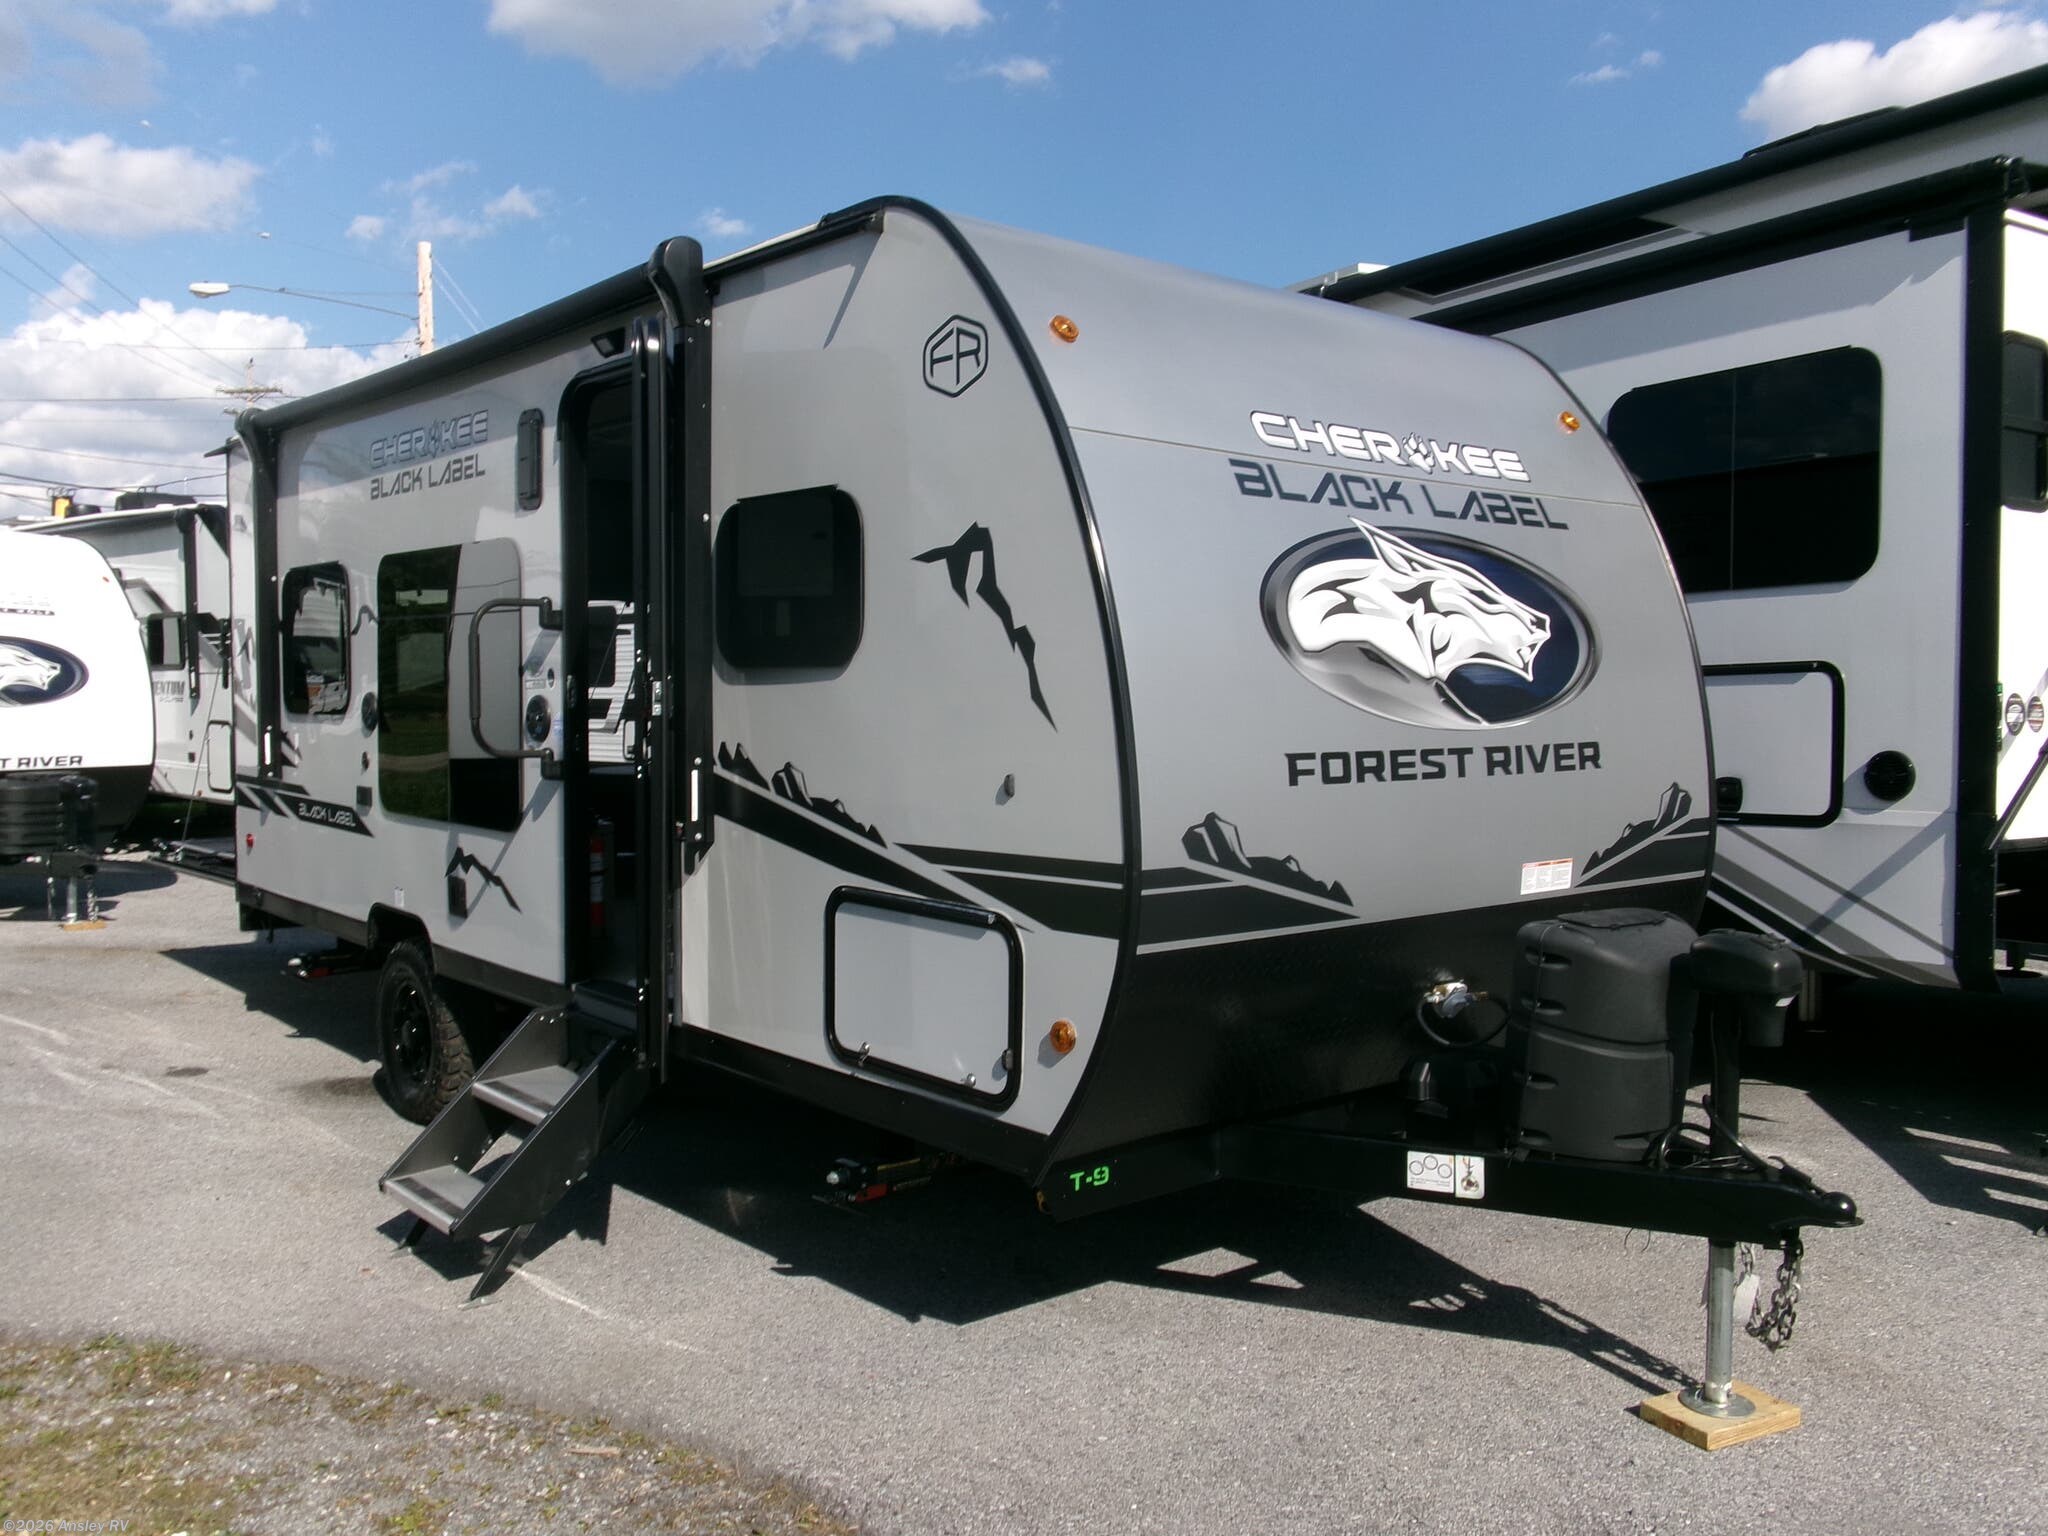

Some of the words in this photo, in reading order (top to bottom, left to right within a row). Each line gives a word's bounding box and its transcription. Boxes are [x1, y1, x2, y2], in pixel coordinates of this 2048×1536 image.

[929, 326, 981, 386] FR
[370, 409, 489, 470] CHEROKEE
[1250, 410, 1531, 482] CHEROKEE
[370, 467, 423, 500] BLACK
[429, 452, 486, 488] LABEL
[1229, 458, 1414, 514] BLACK
[1420, 484, 1569, 530] LABEL
[153, 680, 185, 696] ENTUM
[17, 755, 83, 768] RIVER
[1284, 746, 1474, 786] FOREST
[1483, 741, 1602, 777] RIVER
[299, 802, 327, 820] BLACK
[328, 808, 356, 827] LABEL
[1069, 1166, 1110, 1191] T-9
